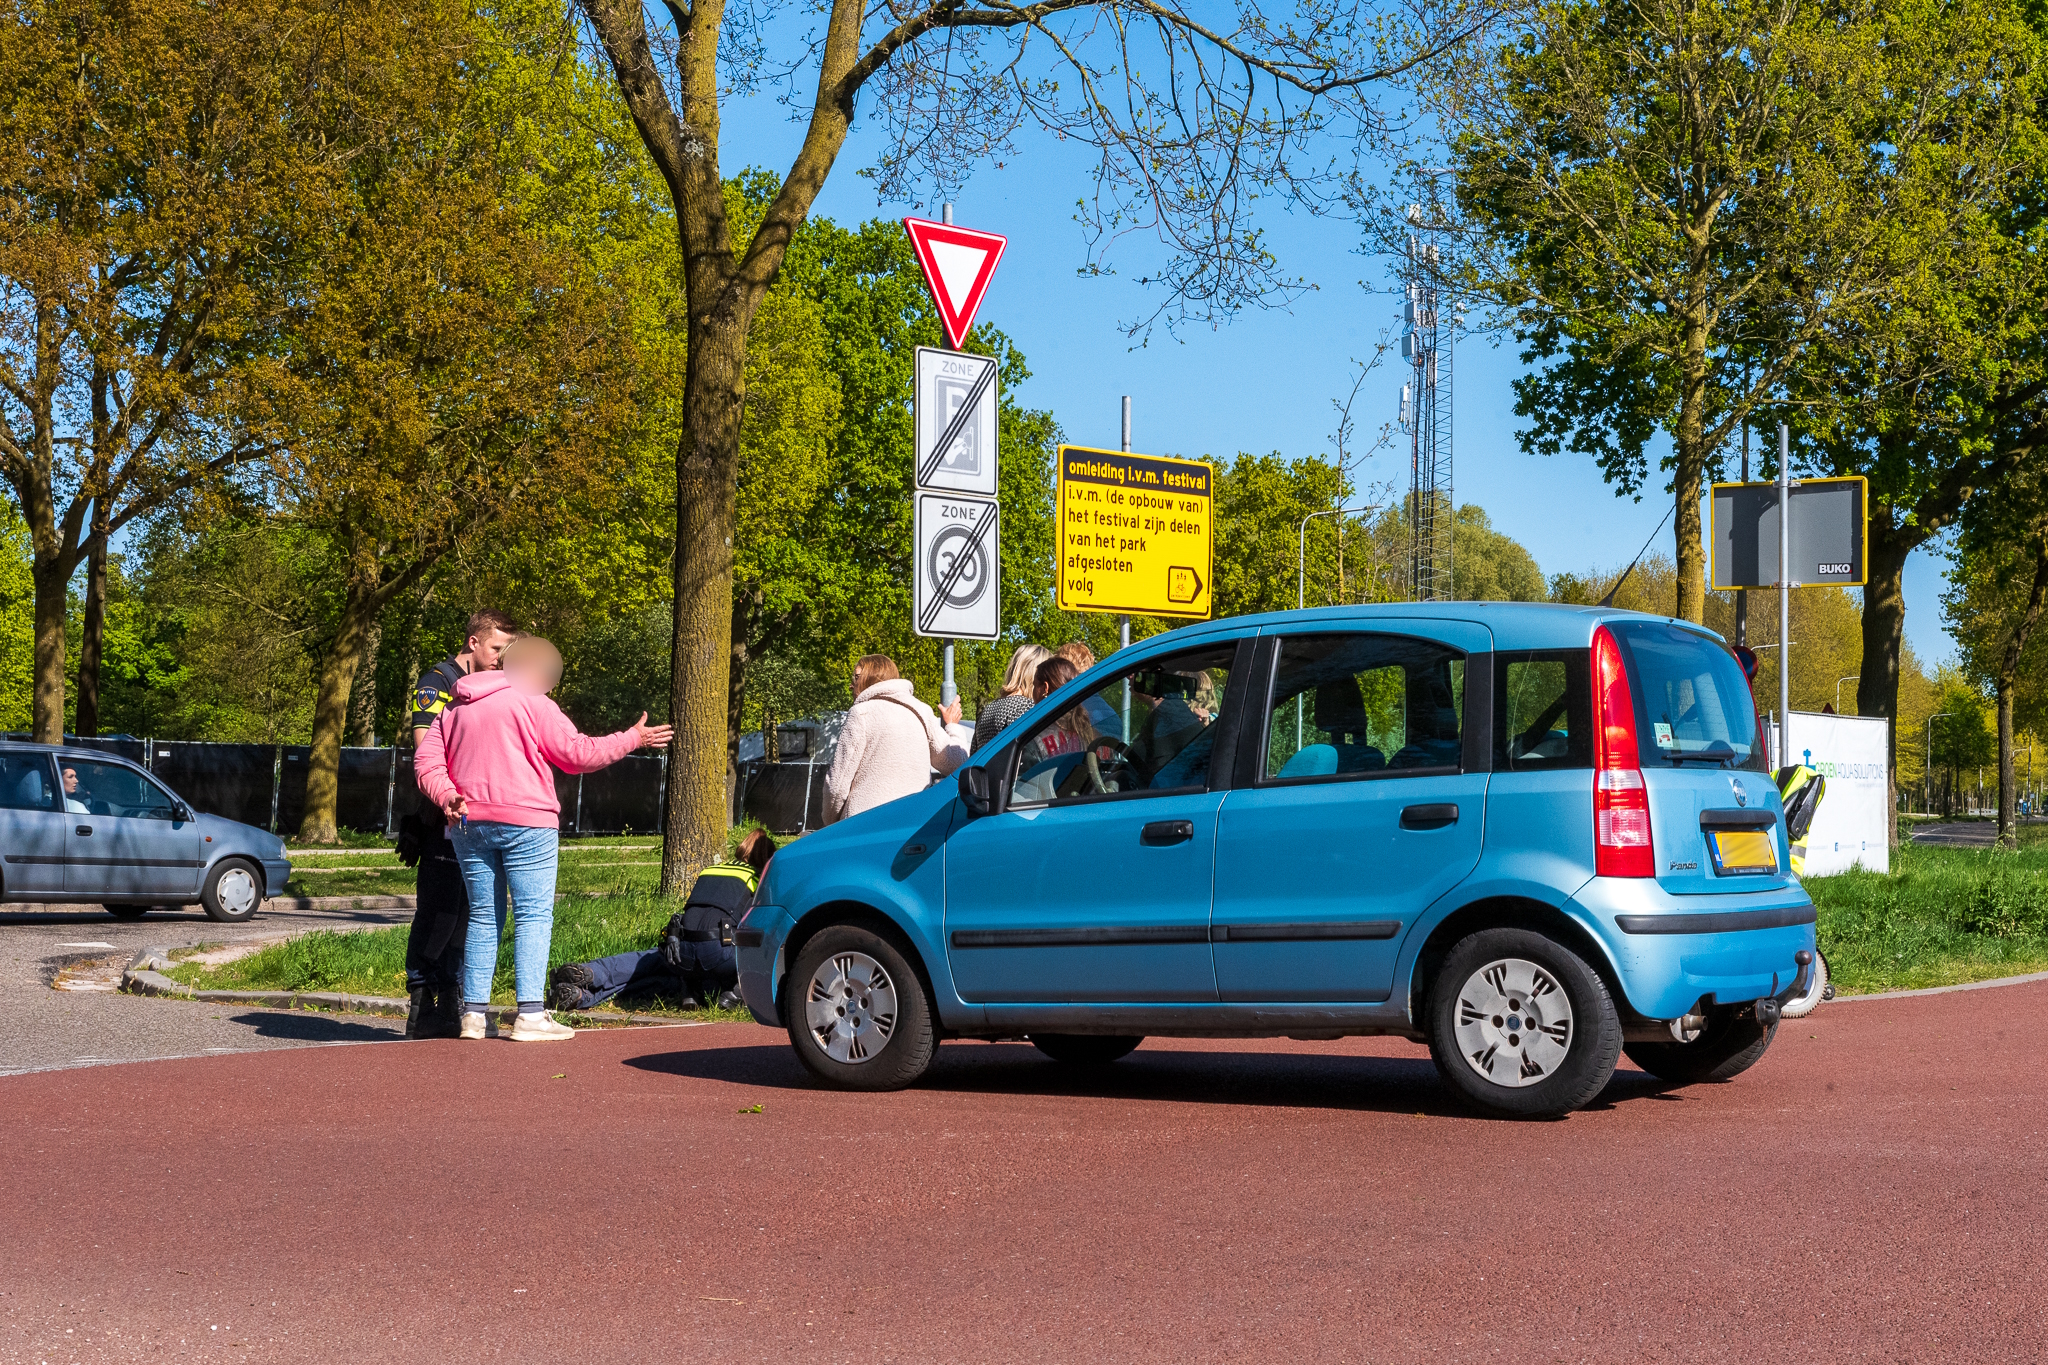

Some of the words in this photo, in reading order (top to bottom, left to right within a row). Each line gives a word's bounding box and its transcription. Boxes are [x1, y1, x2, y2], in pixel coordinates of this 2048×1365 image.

[942, 360, 975, 376] ZONE
[1069, 460, 1124, 484] omleiding
[1128, 466, 1160, 484] i.v.m.
[1163, 470, 1206, 490] festival
[1069, 485, 1102, 502] i.v.m.
[1106, 488, 1124, 505] (de
[1129, 494, 1173, 510] opbouw
[1179, 498, 1203, 514] van)
[941, 505, 976, 520] ZONE
[1069, 508, 1089, 523] het
[1094, 510, 1140, 529] festival
[1144, 517, 1165, 535] zijn
[1170, 519, 1200, 535] delen
[1069, 533, 1091, 546] van
[1095, 533, 1115, 548] het
[1120, 537, 1146, 552] park
[940, 551, 977, 582] 30
[1068, 554, 1133, 573] afgesloten
[1068, 577, 1093, 596] volg
